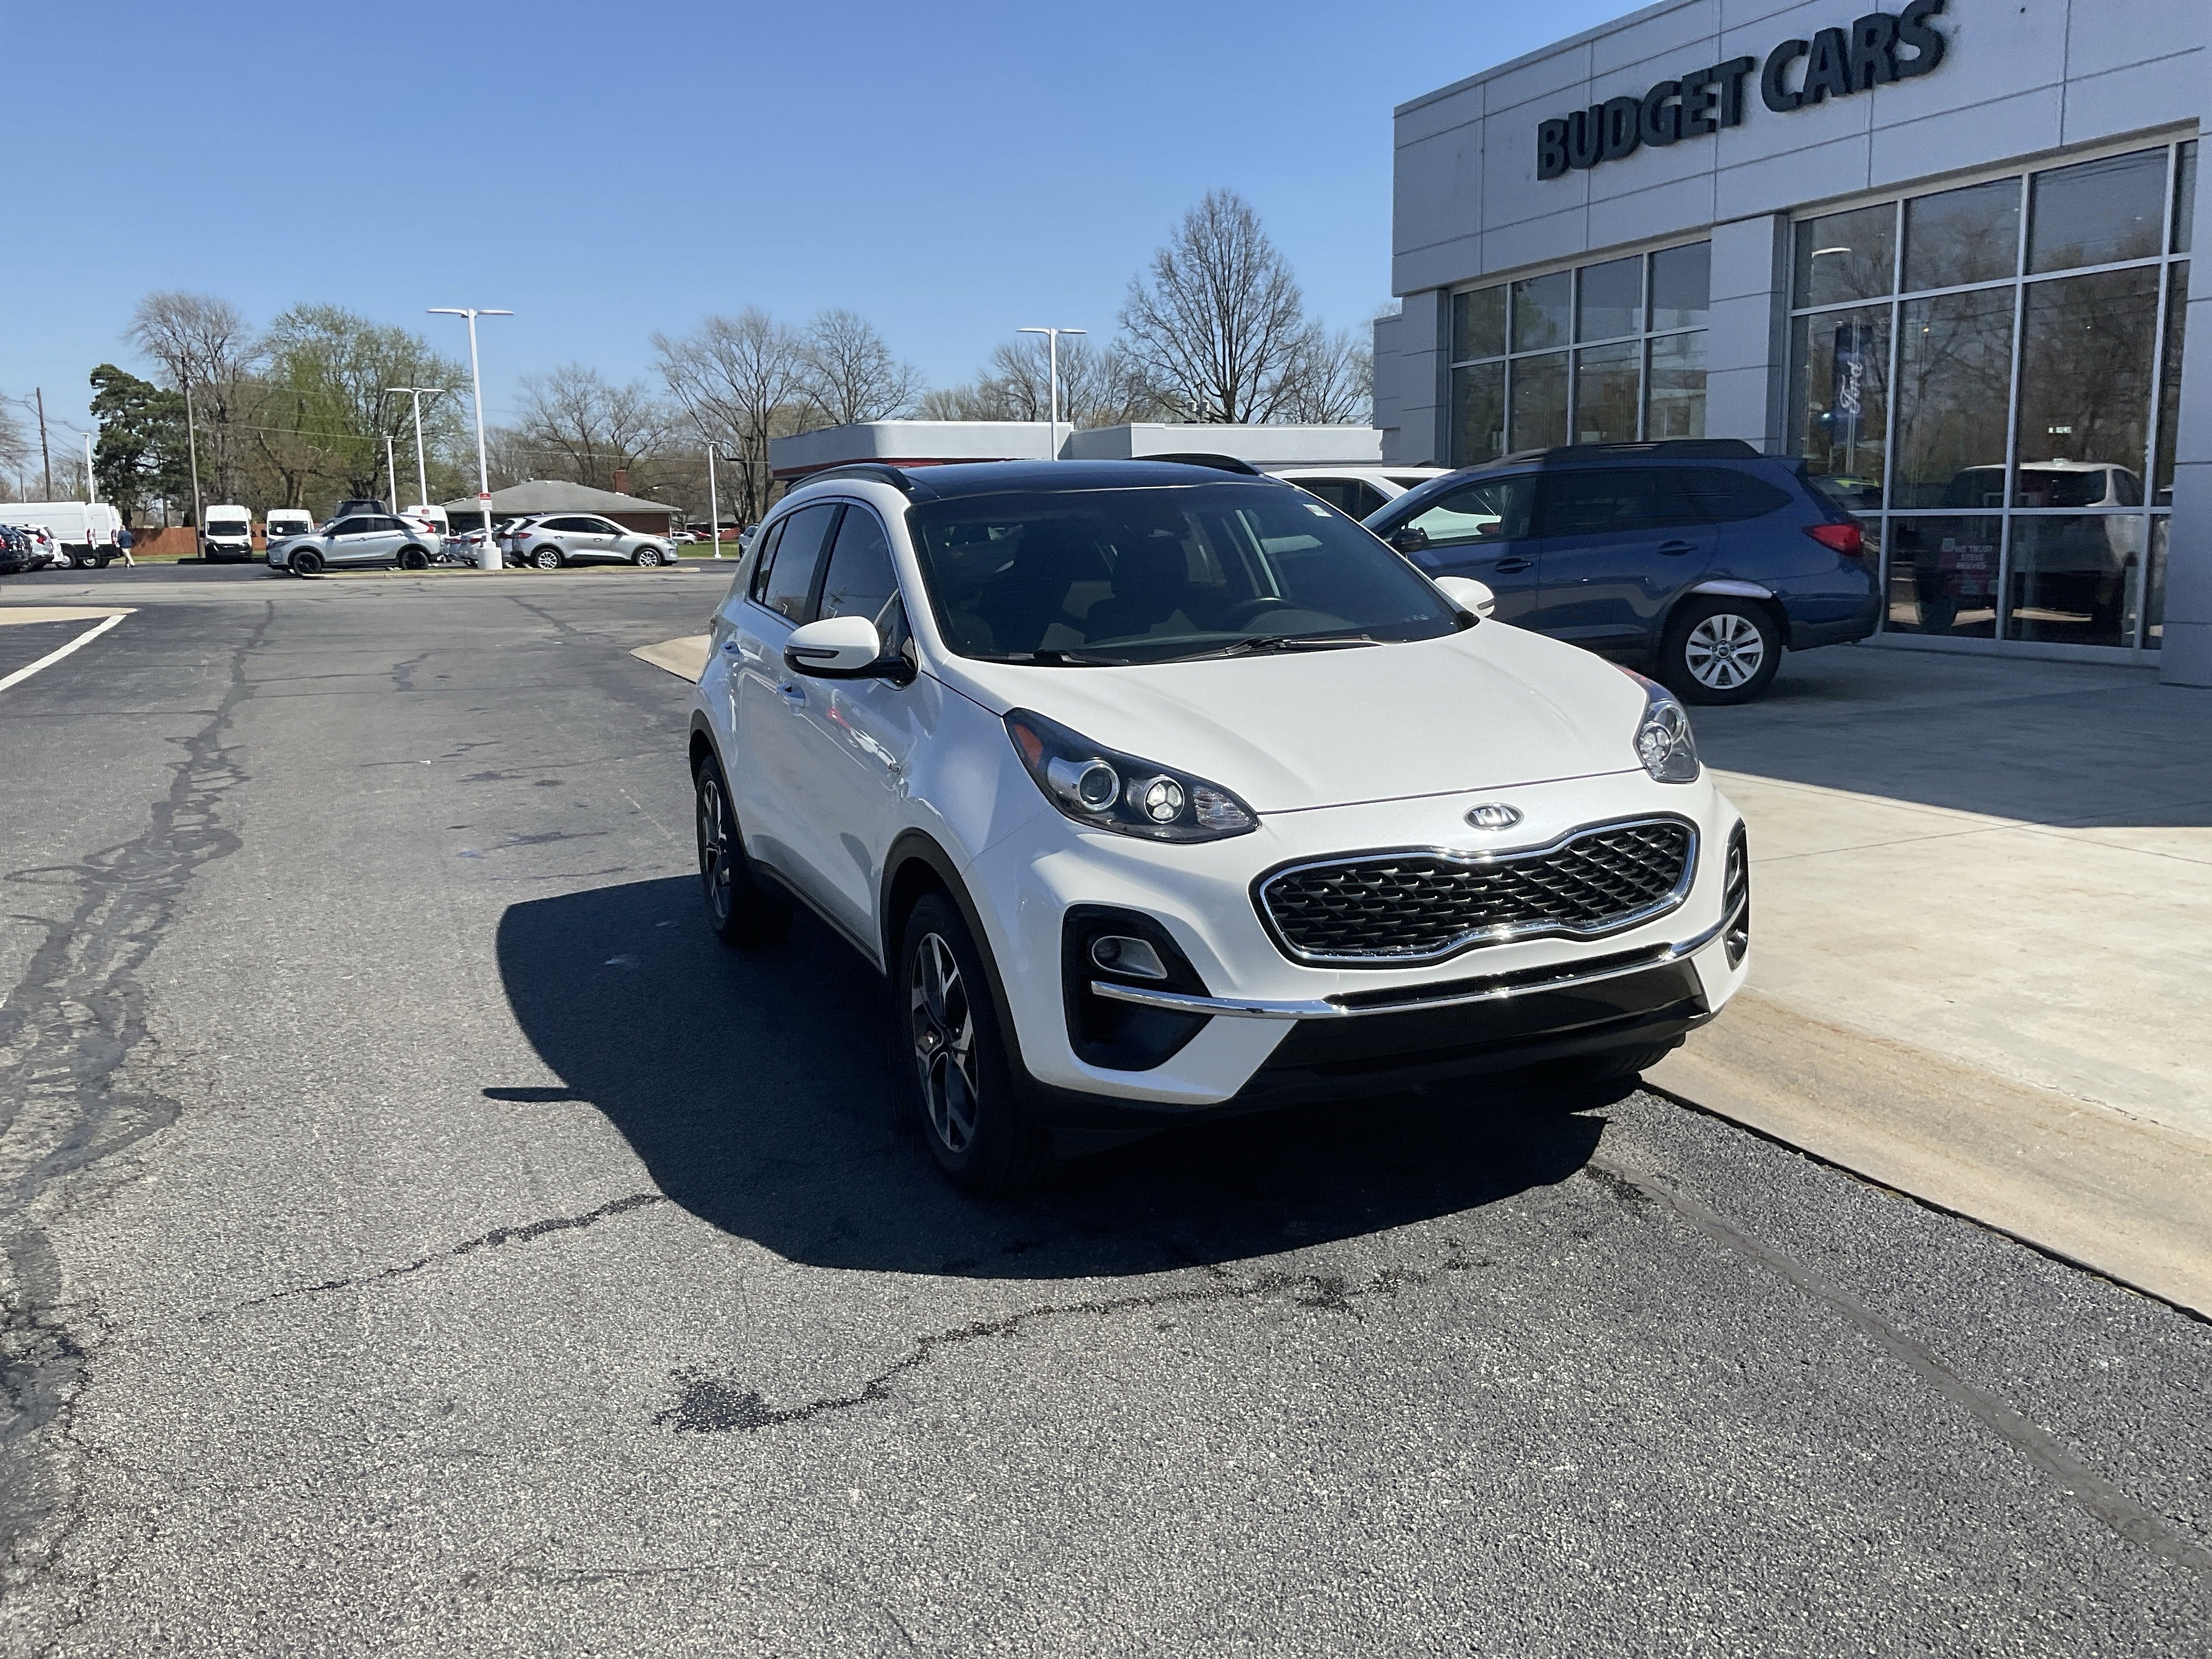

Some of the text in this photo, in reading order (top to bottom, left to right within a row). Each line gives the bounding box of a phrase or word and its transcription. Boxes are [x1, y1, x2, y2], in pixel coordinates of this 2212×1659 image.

[1537, 0, 1945, 180] BUDGET CARS
[1839, 360, 1863, 414] Ford
[1472, 807, 1516, 825] KIA
